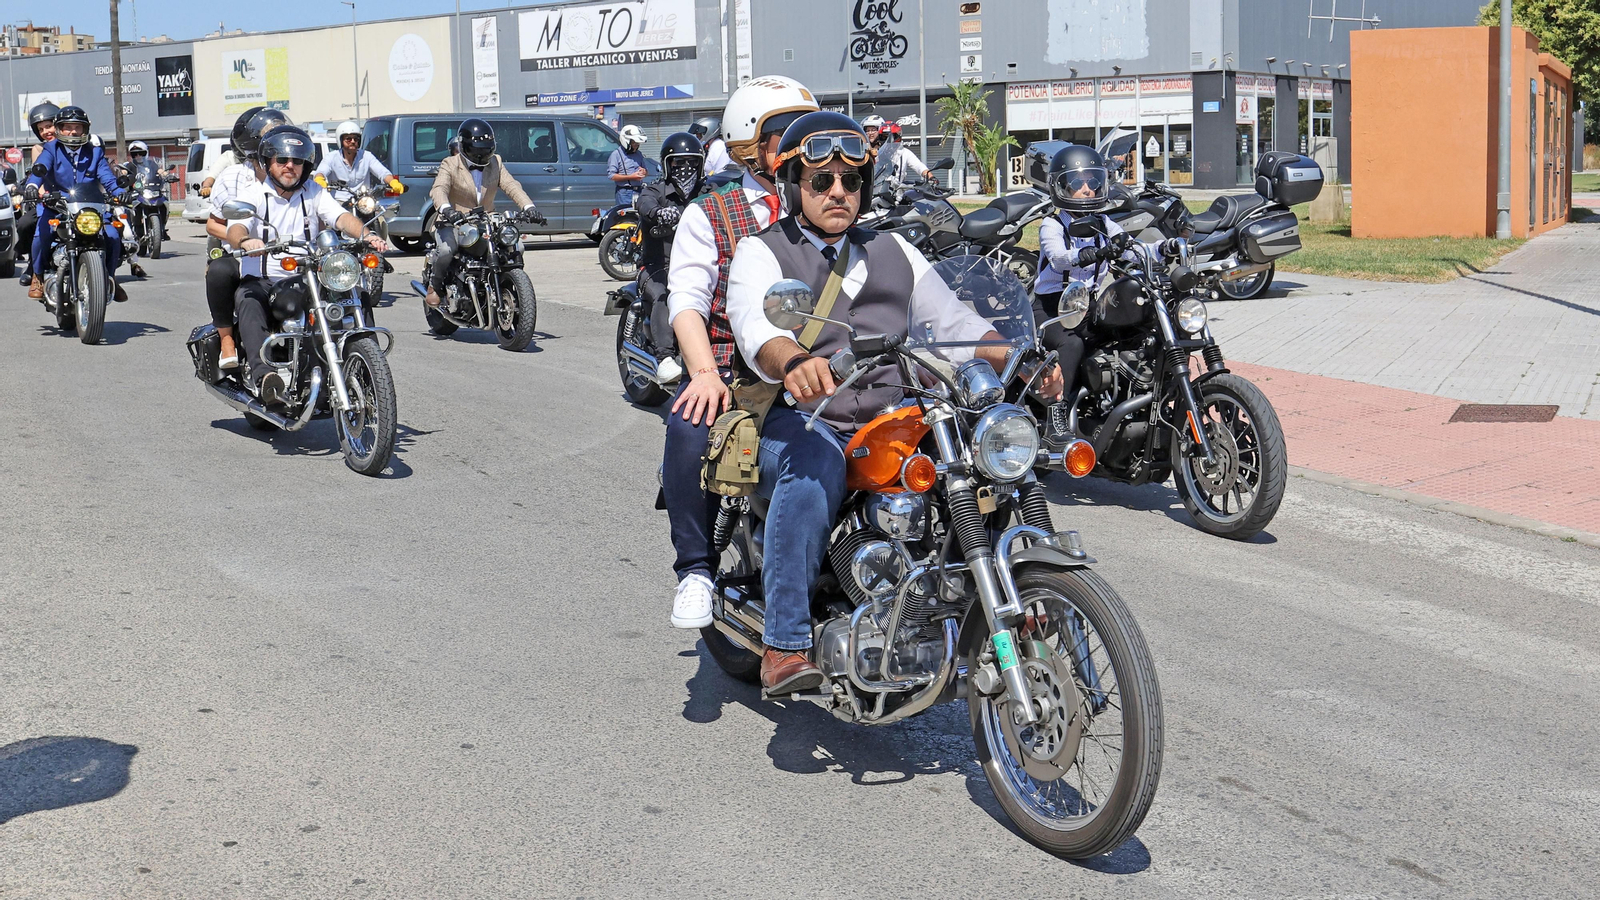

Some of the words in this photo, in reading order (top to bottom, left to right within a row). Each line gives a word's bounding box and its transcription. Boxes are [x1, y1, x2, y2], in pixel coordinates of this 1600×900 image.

[853, 0, 903, 30] Cool
[637, 32, 672, 44] JEREZ
[536, 58, 570, 70] TALLER
[572, 53, 626, 67] MECANICO
[628, 52, 636, 63] Y
[638, 49, 679, 62] VENTAS
[121, 61, 151, 74] MONTAÑA
[158, 73, 180, 87] YAK
[1101, 78, 1136, 93] AGILIDAD
[559, 94, 577, 102] ZONE
[616, 91, 629, 99] MOTO
[629, 90, 640, 98] LINE
[640, 89, 654, 97] JEREZ
[1008, 84, 1048, 99] POTENCIA
[1053, 80, 1094, 96] EQUILIBRIO
